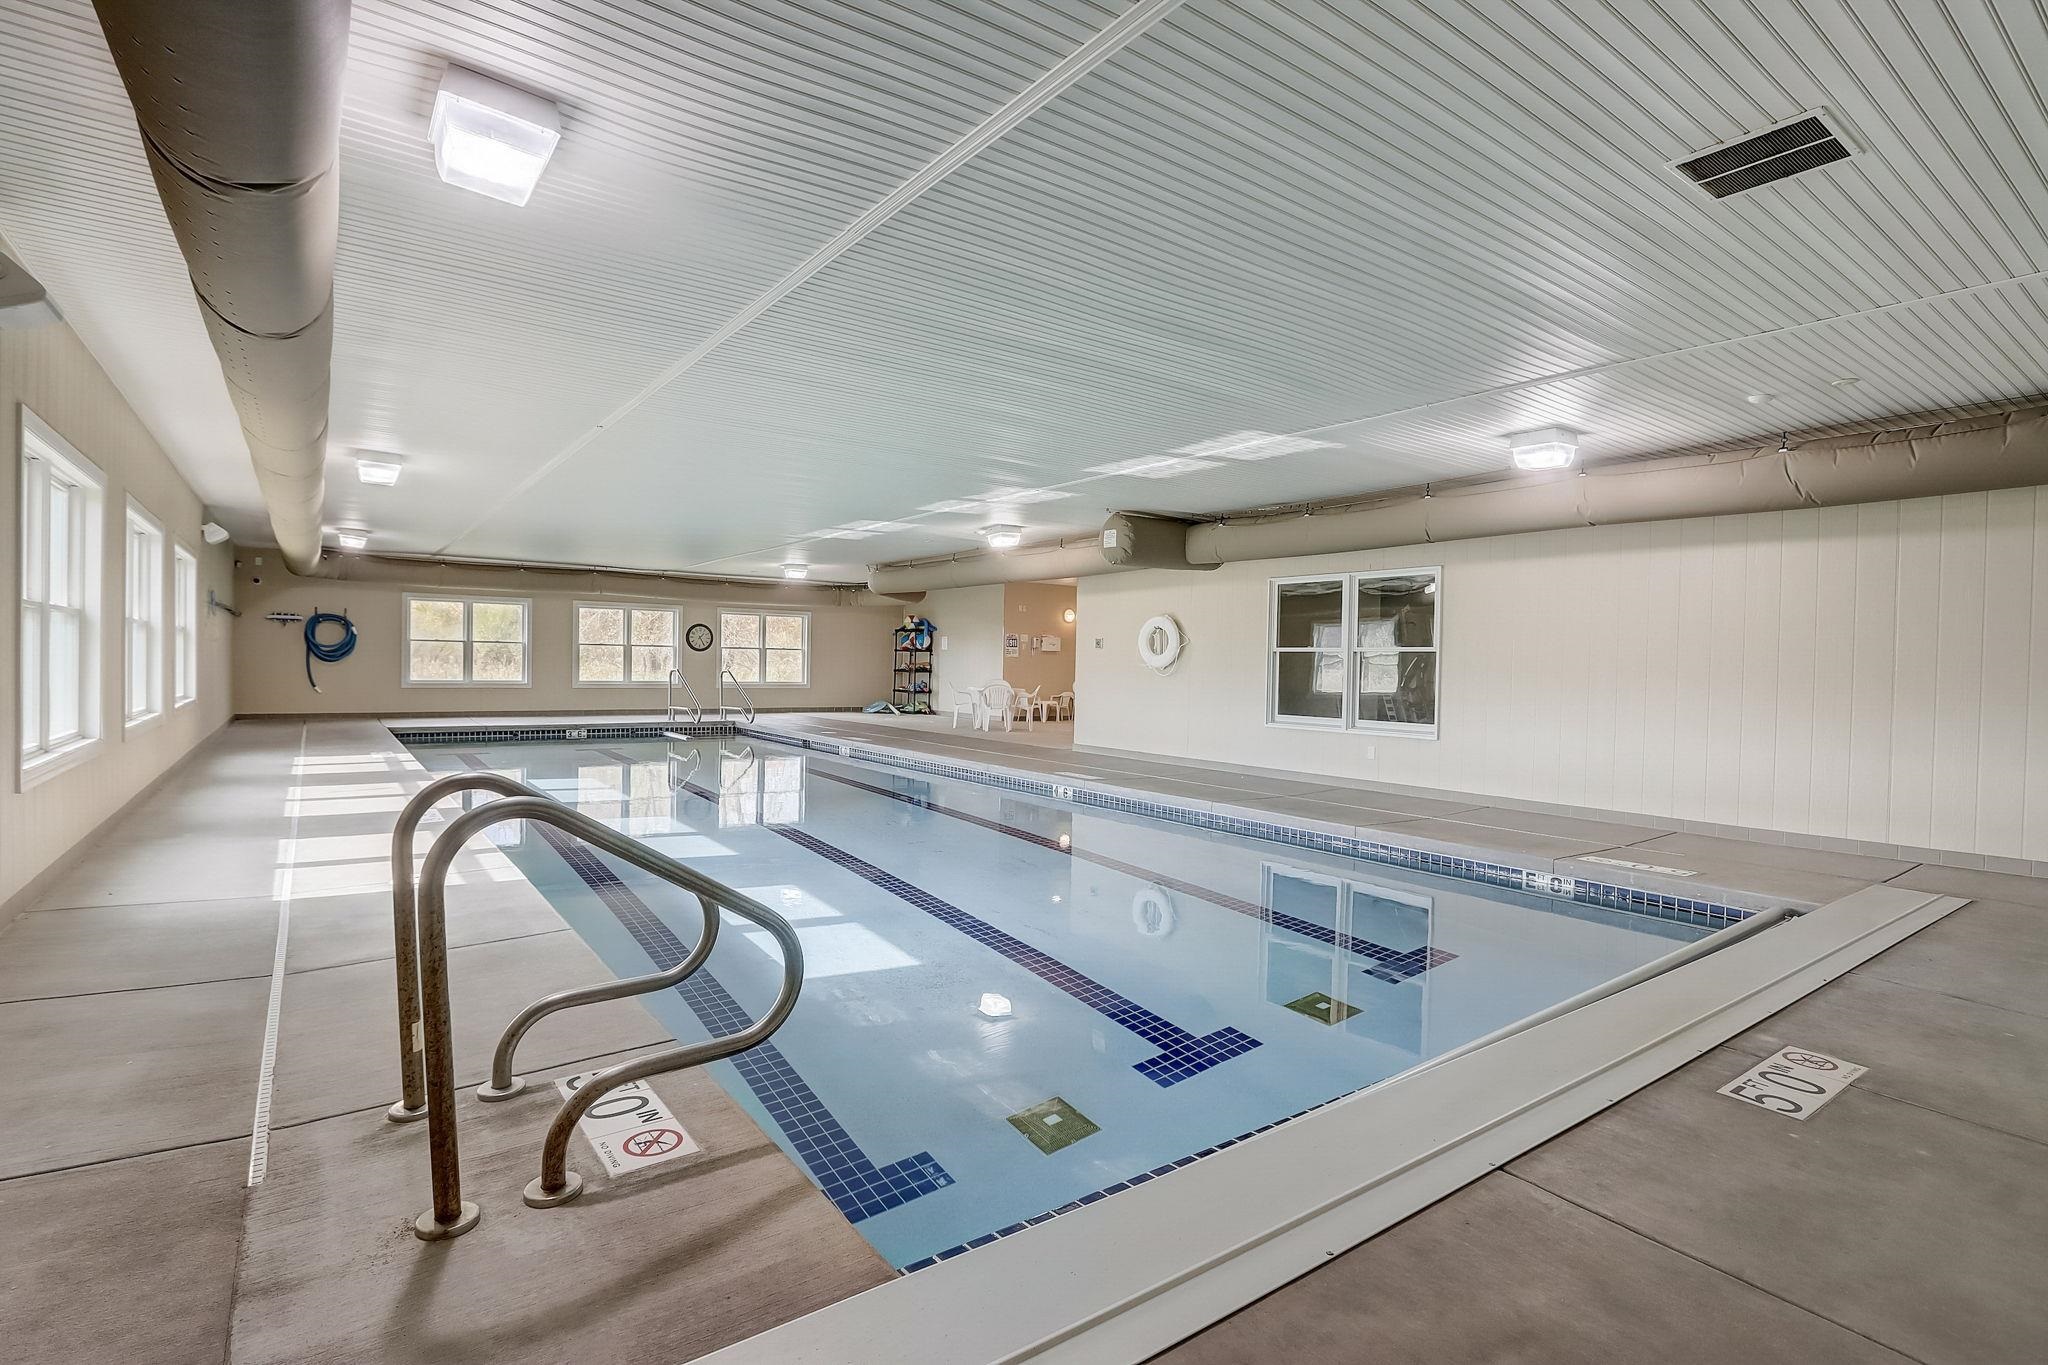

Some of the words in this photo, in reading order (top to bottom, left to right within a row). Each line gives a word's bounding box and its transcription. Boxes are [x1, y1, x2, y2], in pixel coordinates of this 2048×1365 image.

[1563, 878, 1572, 886] IN
[1742, 1079, 1769, 1090] FT
[1729, 1085, 1803, 1113] 5
[636, 1109, 663, 1123] IN
[599, 1141, 609, 1150] NO
[604, 1150, 621, 1168] DIVING
